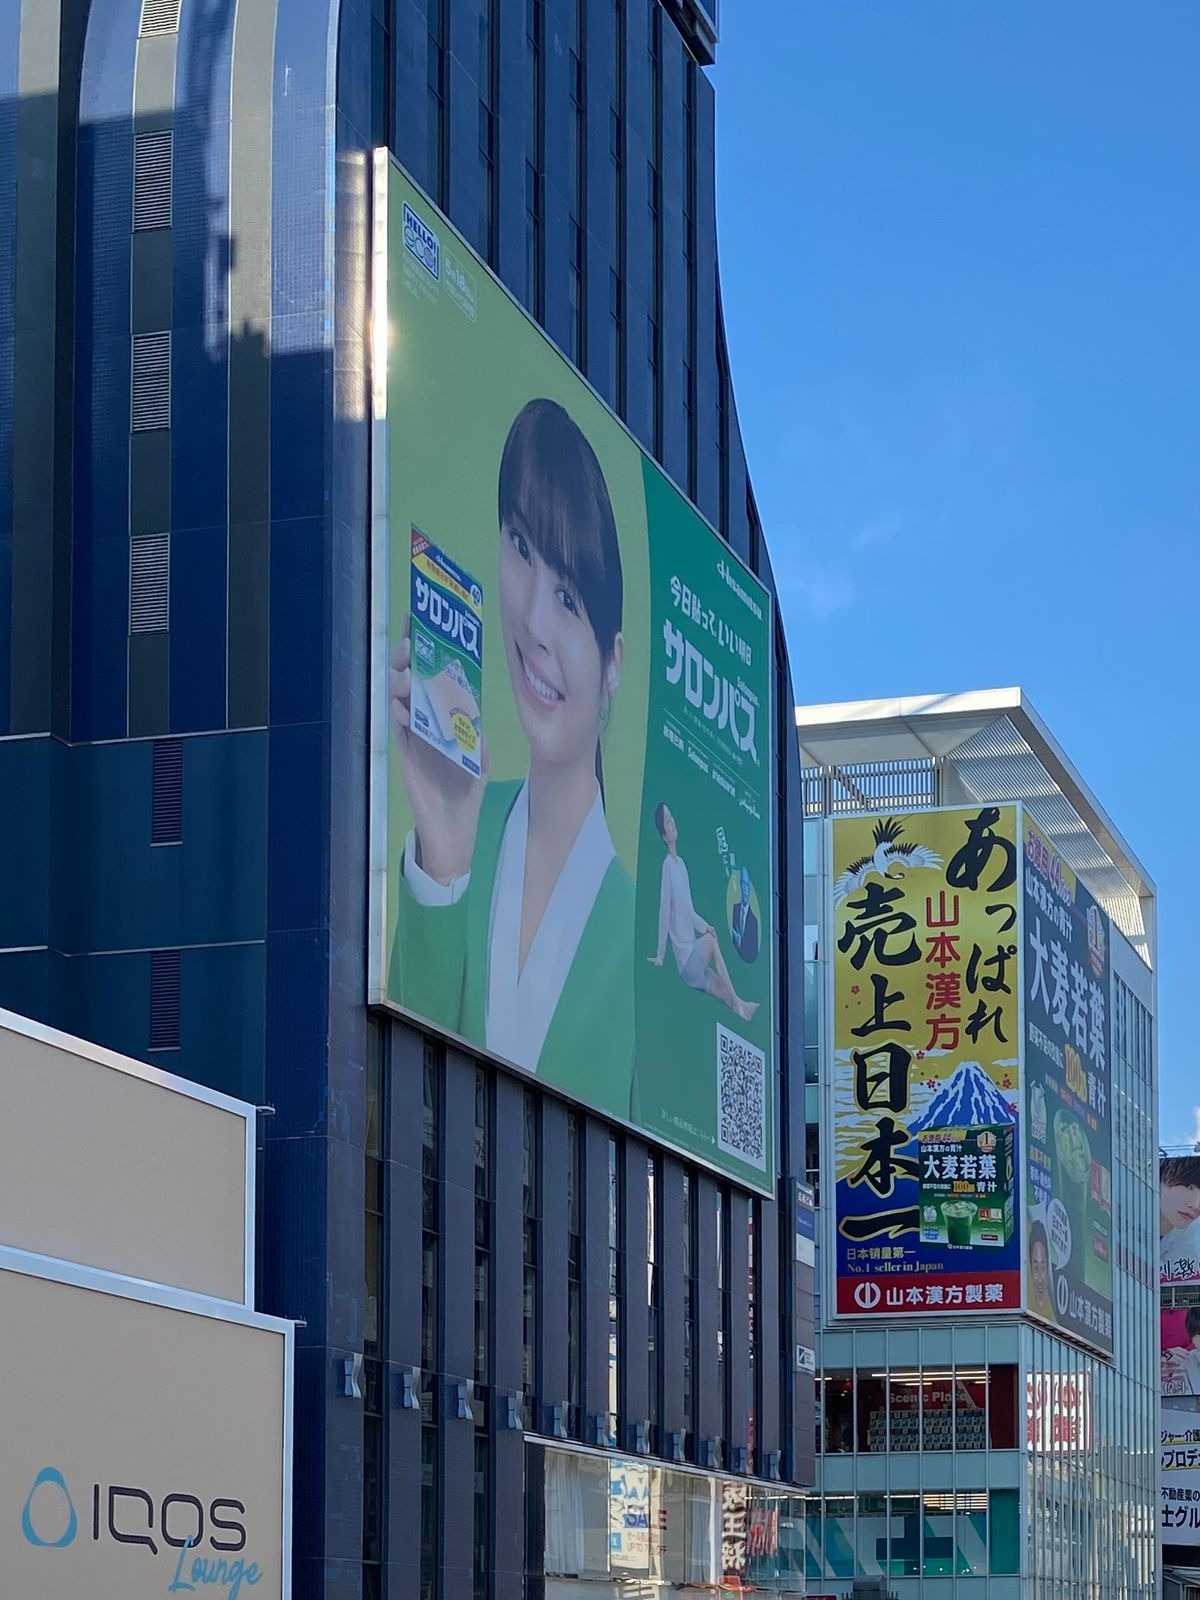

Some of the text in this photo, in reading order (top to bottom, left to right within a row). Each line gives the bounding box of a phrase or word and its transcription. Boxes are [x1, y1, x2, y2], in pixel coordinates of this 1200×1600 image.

[415, 576, 480, 661] サロンパス
[663, 618, 761, 766] サロンパス
[945, 805, 1019, 1046] あっぱれ
[924, 890, 962, 1053] 山本漢方
[1029, 915, 1107, 1073] 大麦若葉
[836, 881, 923, 1243] 売上日本一
[923, 1153, 998, 1180] 大麦若葉
[976, 1180, 998, 1194] 青汁
[846, 1246, 916, 1260] 日本销量第一
[874, 1261, 902, 1272] seller
[903, 1261, 913, 1271] in
[914, 1260, 944, 1274] Japan
[886, 1283, 1004, 1307] 山本漢方製薬
[1068, 1290, 1113, 1342] 山本漢方製薬
[889, 1391, 929, 1404] Scenc
[93, 1483, 247, 1556] IQOS
